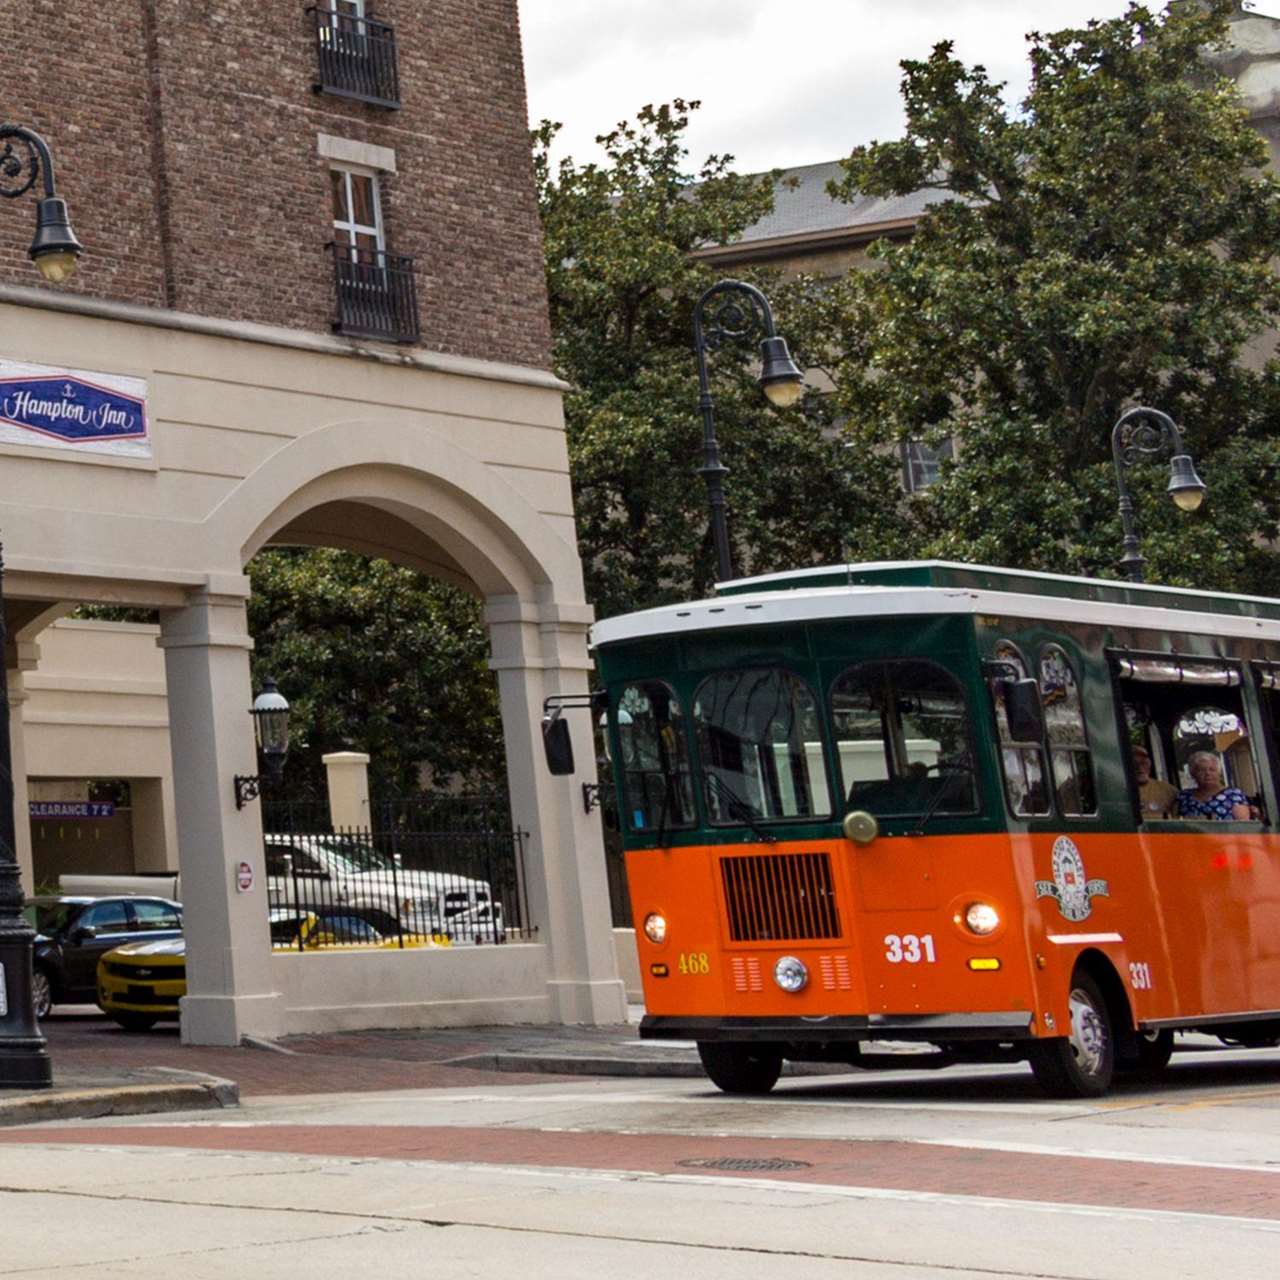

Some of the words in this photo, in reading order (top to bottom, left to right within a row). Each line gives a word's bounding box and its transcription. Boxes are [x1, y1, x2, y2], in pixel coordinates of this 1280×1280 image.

[4, 390, 90, 425] Hampton
[92, 402, 135, 430] Inn
[29, 803, 88, 816] CLEARANCE
[884, 934, 936, 963] 331
[678, 953, 709, 974] 468
[1129, 962, 1152, 989] 331
